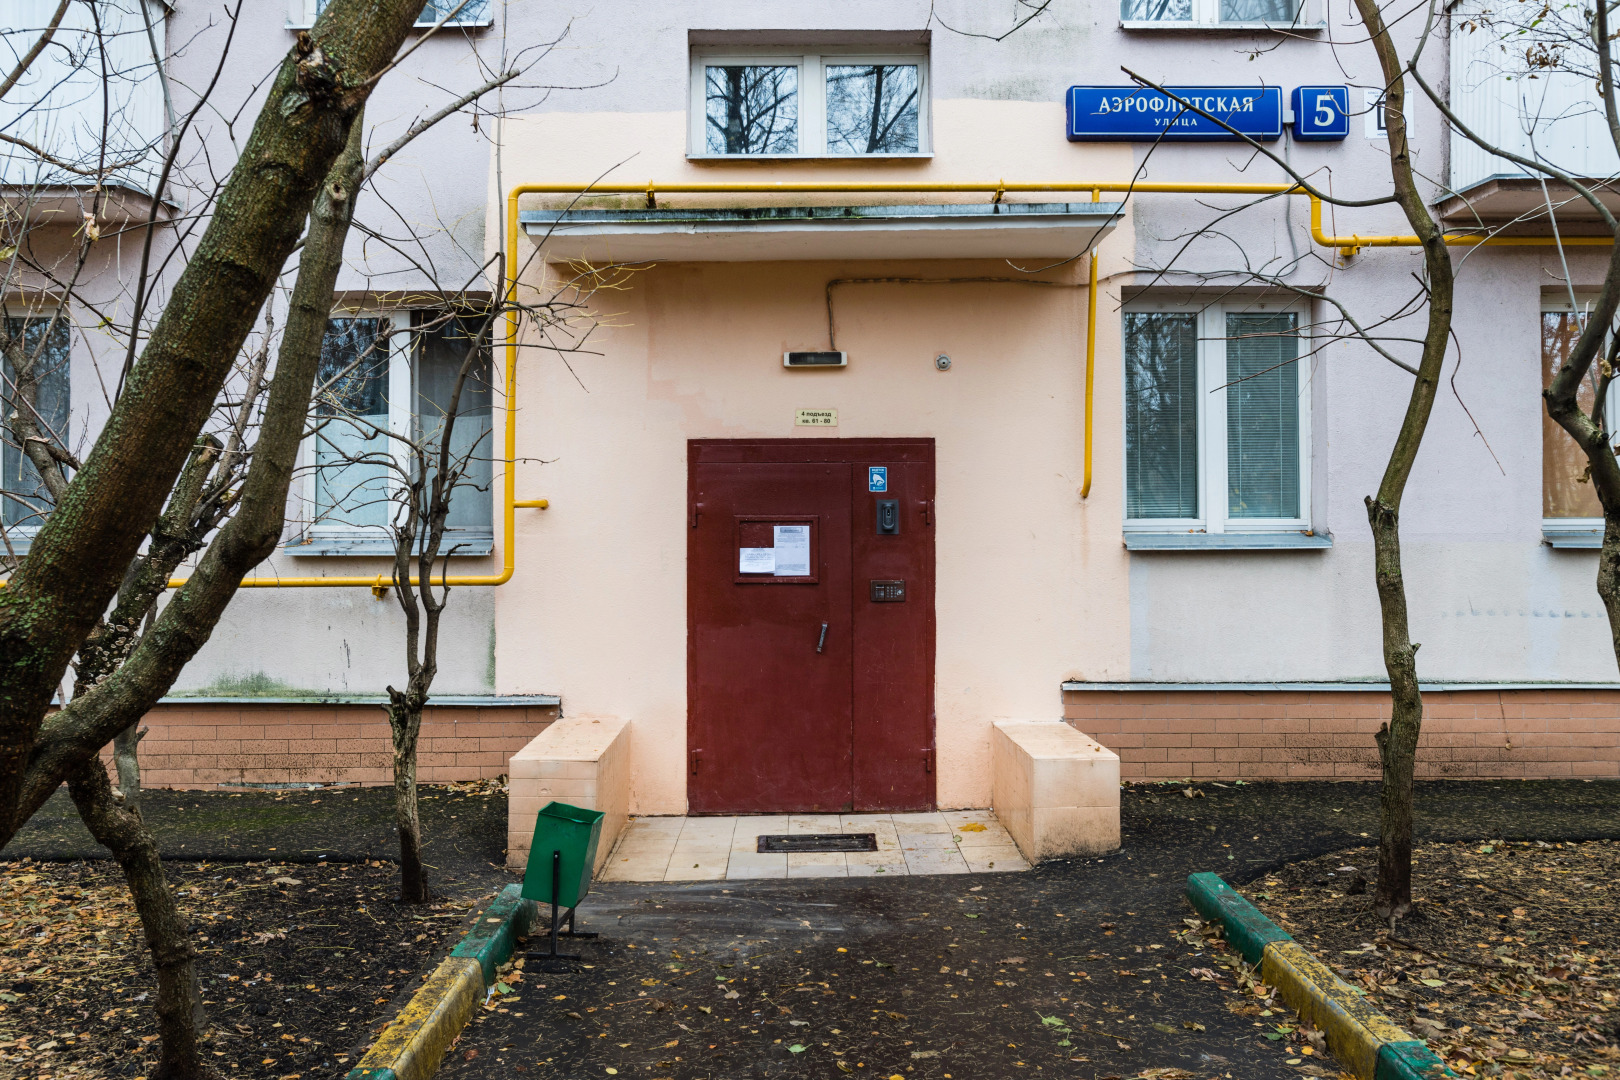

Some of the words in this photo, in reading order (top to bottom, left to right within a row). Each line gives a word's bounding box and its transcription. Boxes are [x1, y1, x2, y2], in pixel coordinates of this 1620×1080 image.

[1098, 96, 1254, 113] АЭРОФЛОТСКАЯ
[1313, 94, 1336, 127] 5
[1154, 118, 1198, 127] УЛИЦА
